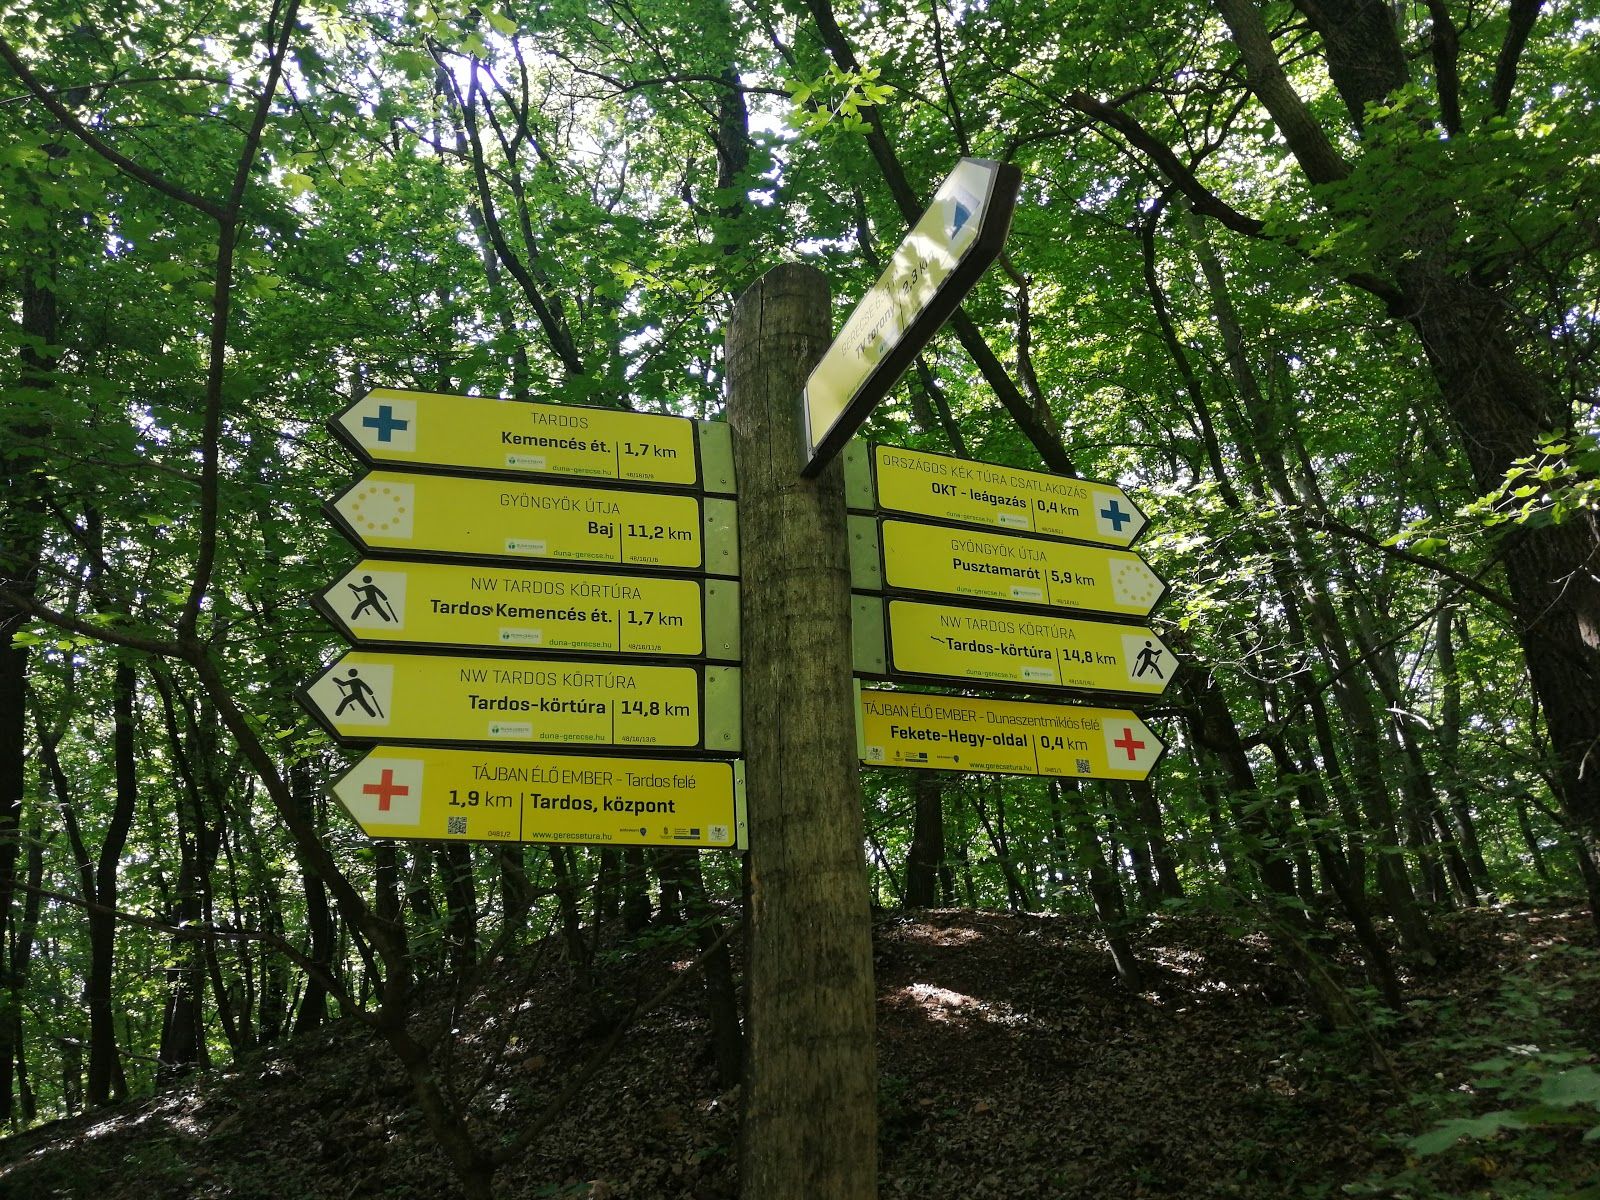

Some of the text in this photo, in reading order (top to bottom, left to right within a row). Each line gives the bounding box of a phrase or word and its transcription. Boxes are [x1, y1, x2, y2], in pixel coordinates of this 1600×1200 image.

[531, 412, 589, 429] TARDOS
[501, 432, 611, 453] Kemencés ét.
[624, 442, 677, 458] 1,7 km
[883, 455, 1088, 500] ORSZÁGOS KÉK TÚRA CSATLAKOZÁS
[500, 493, 621, 515] GYÖNGYÖK ÚTJA
[931, 482, 957, 497] OKT
[970, 488, 1027, 509] leágazás
[1037, 500, 1080, 517] 0,4 km
[588, 521, 613, 538] Baj
[628, 524, 692, 540] 11,2 km
[951, 539, 1048, 562] GYÖNGYÖK ÚTJA
[953, 558, 1041, 579] Pusztamarót
[1051, 570, 1095, 586] 5,9 km
[471, 577, 641, 600] NW TARDOS KÖRTÚRA
[496, 603, 586, 622] Kemencés
[590, 607, 612, 623] ét.
[627, 610, 683, 626] 1,7 km
[940, 615, 1076, 640] NW TARDOS KÖRTÚRA
[549, 638, 612, 649] duna-gerecse.hu
[945, 637, 1052, 660] Tardos-körtúra
[1063, 649, 1117, 665] 14,8 km
[460, 668, 637, 689] NW TARDOS KÖRTÚRA
[468, 694, 606, 714] Tardos-körtúra
[621, 700, 690, 717] 14,8 km
[863, 700, 909, 718] TÁJBAN
[912, 703, 933, 719] ÉLŐ
[935, 707, 977, 722] EMBER
[987, 711, 1079, 730] Dunaszentmiklós
[1081, 717, 1100, 731] felé
[539, 732, 605, 742] duna-gerecse.hu
[890, 725, 1028, 747] Fekete-Hegy-oldal
[1041, 735, 1088, 751] 0,4 km
[472, 763, 528, 782] TÁJBAN
[532, 765, 559, 783] ÉLŐ
[562, 769, 613, 786] EMBER
[625, 772, 670, 788] Tardos
[673, 774, 696, 789] felé
[448, 790, 513, 808] 1,9 km
[530, 793, 676, 816] Tardos, központ
[532, 832, 612, 841] www.gerecsetura.hu
